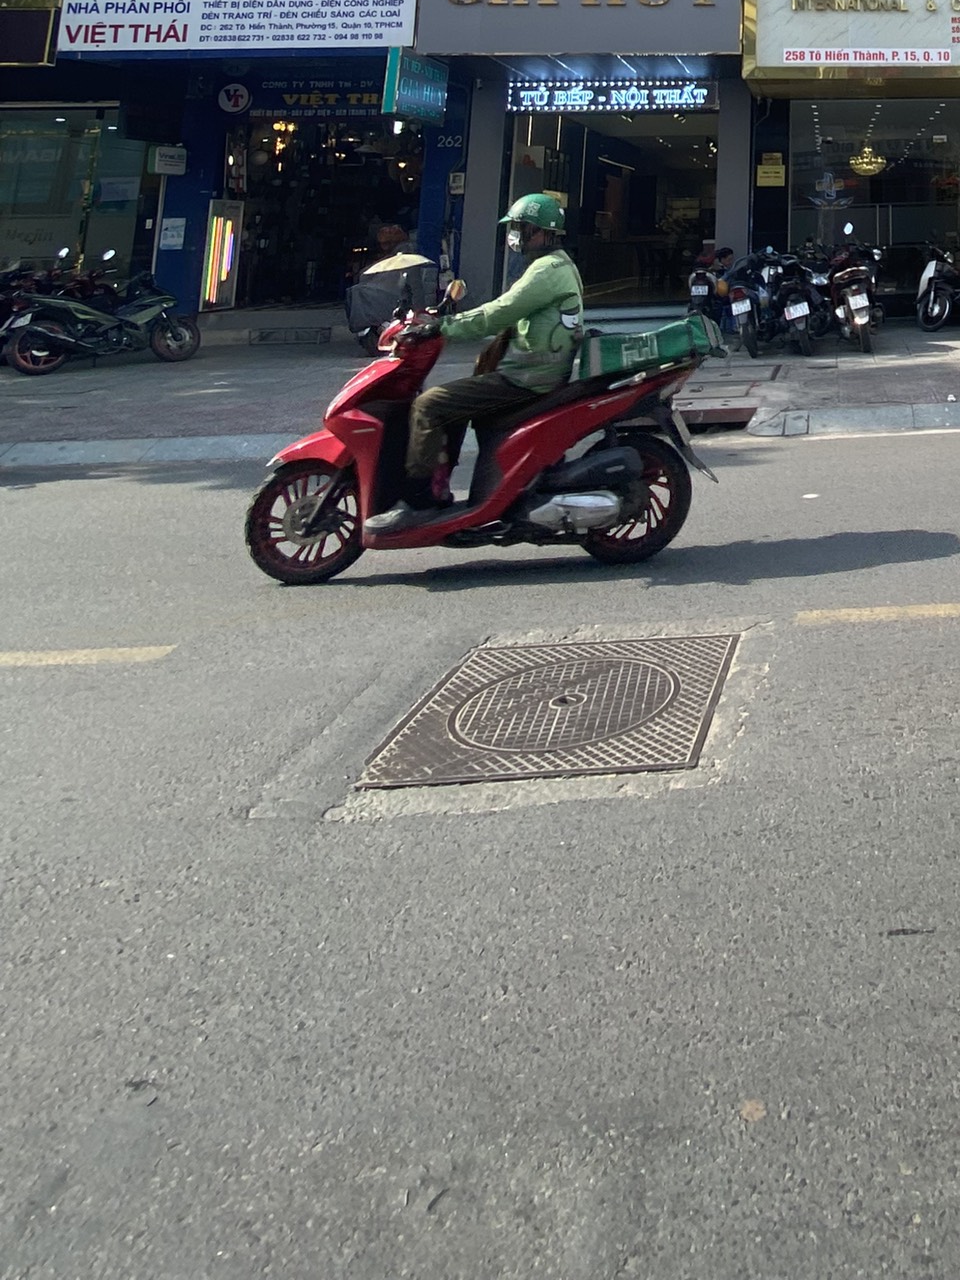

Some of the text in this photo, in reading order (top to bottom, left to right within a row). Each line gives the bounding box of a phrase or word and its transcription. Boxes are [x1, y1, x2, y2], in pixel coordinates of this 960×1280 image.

[66, 0, 101, 14] NHÀ
[104, 0, 151, 14] PHÂN
[289, 0, 313, 9] DỤNG
[223, 12, 255, 20] TRANG
[257, 10, 272, 19] TRÍ
[330, 10, 355, 18] SÁNG
[359, 9, 378, 18] CÁC
[219, 23, 233, 31] 262
[296, 22, 327, 31] Phường
[341, 22, 362, 30] Quận
[375, 21, 403, 29] TPHCM
[65, 19, 188, 48] VIỆT THÁI
[785, 51, 806, 61] 258
[809, 50, 822, 61] Tô
[825, 49, 849, 61] Hiến
[853, 50, 888, 62] Thành,
[891, 51, 900, 61] P.
[923, 51, 934, 62] Q.
[937, 51, 950, 61] 10
[282, 90, 341, 109] VIỆT
[520, 84, 708, 110] TỦ BẾP NỘI THẤT
[437, 135, 463, 148] 262
